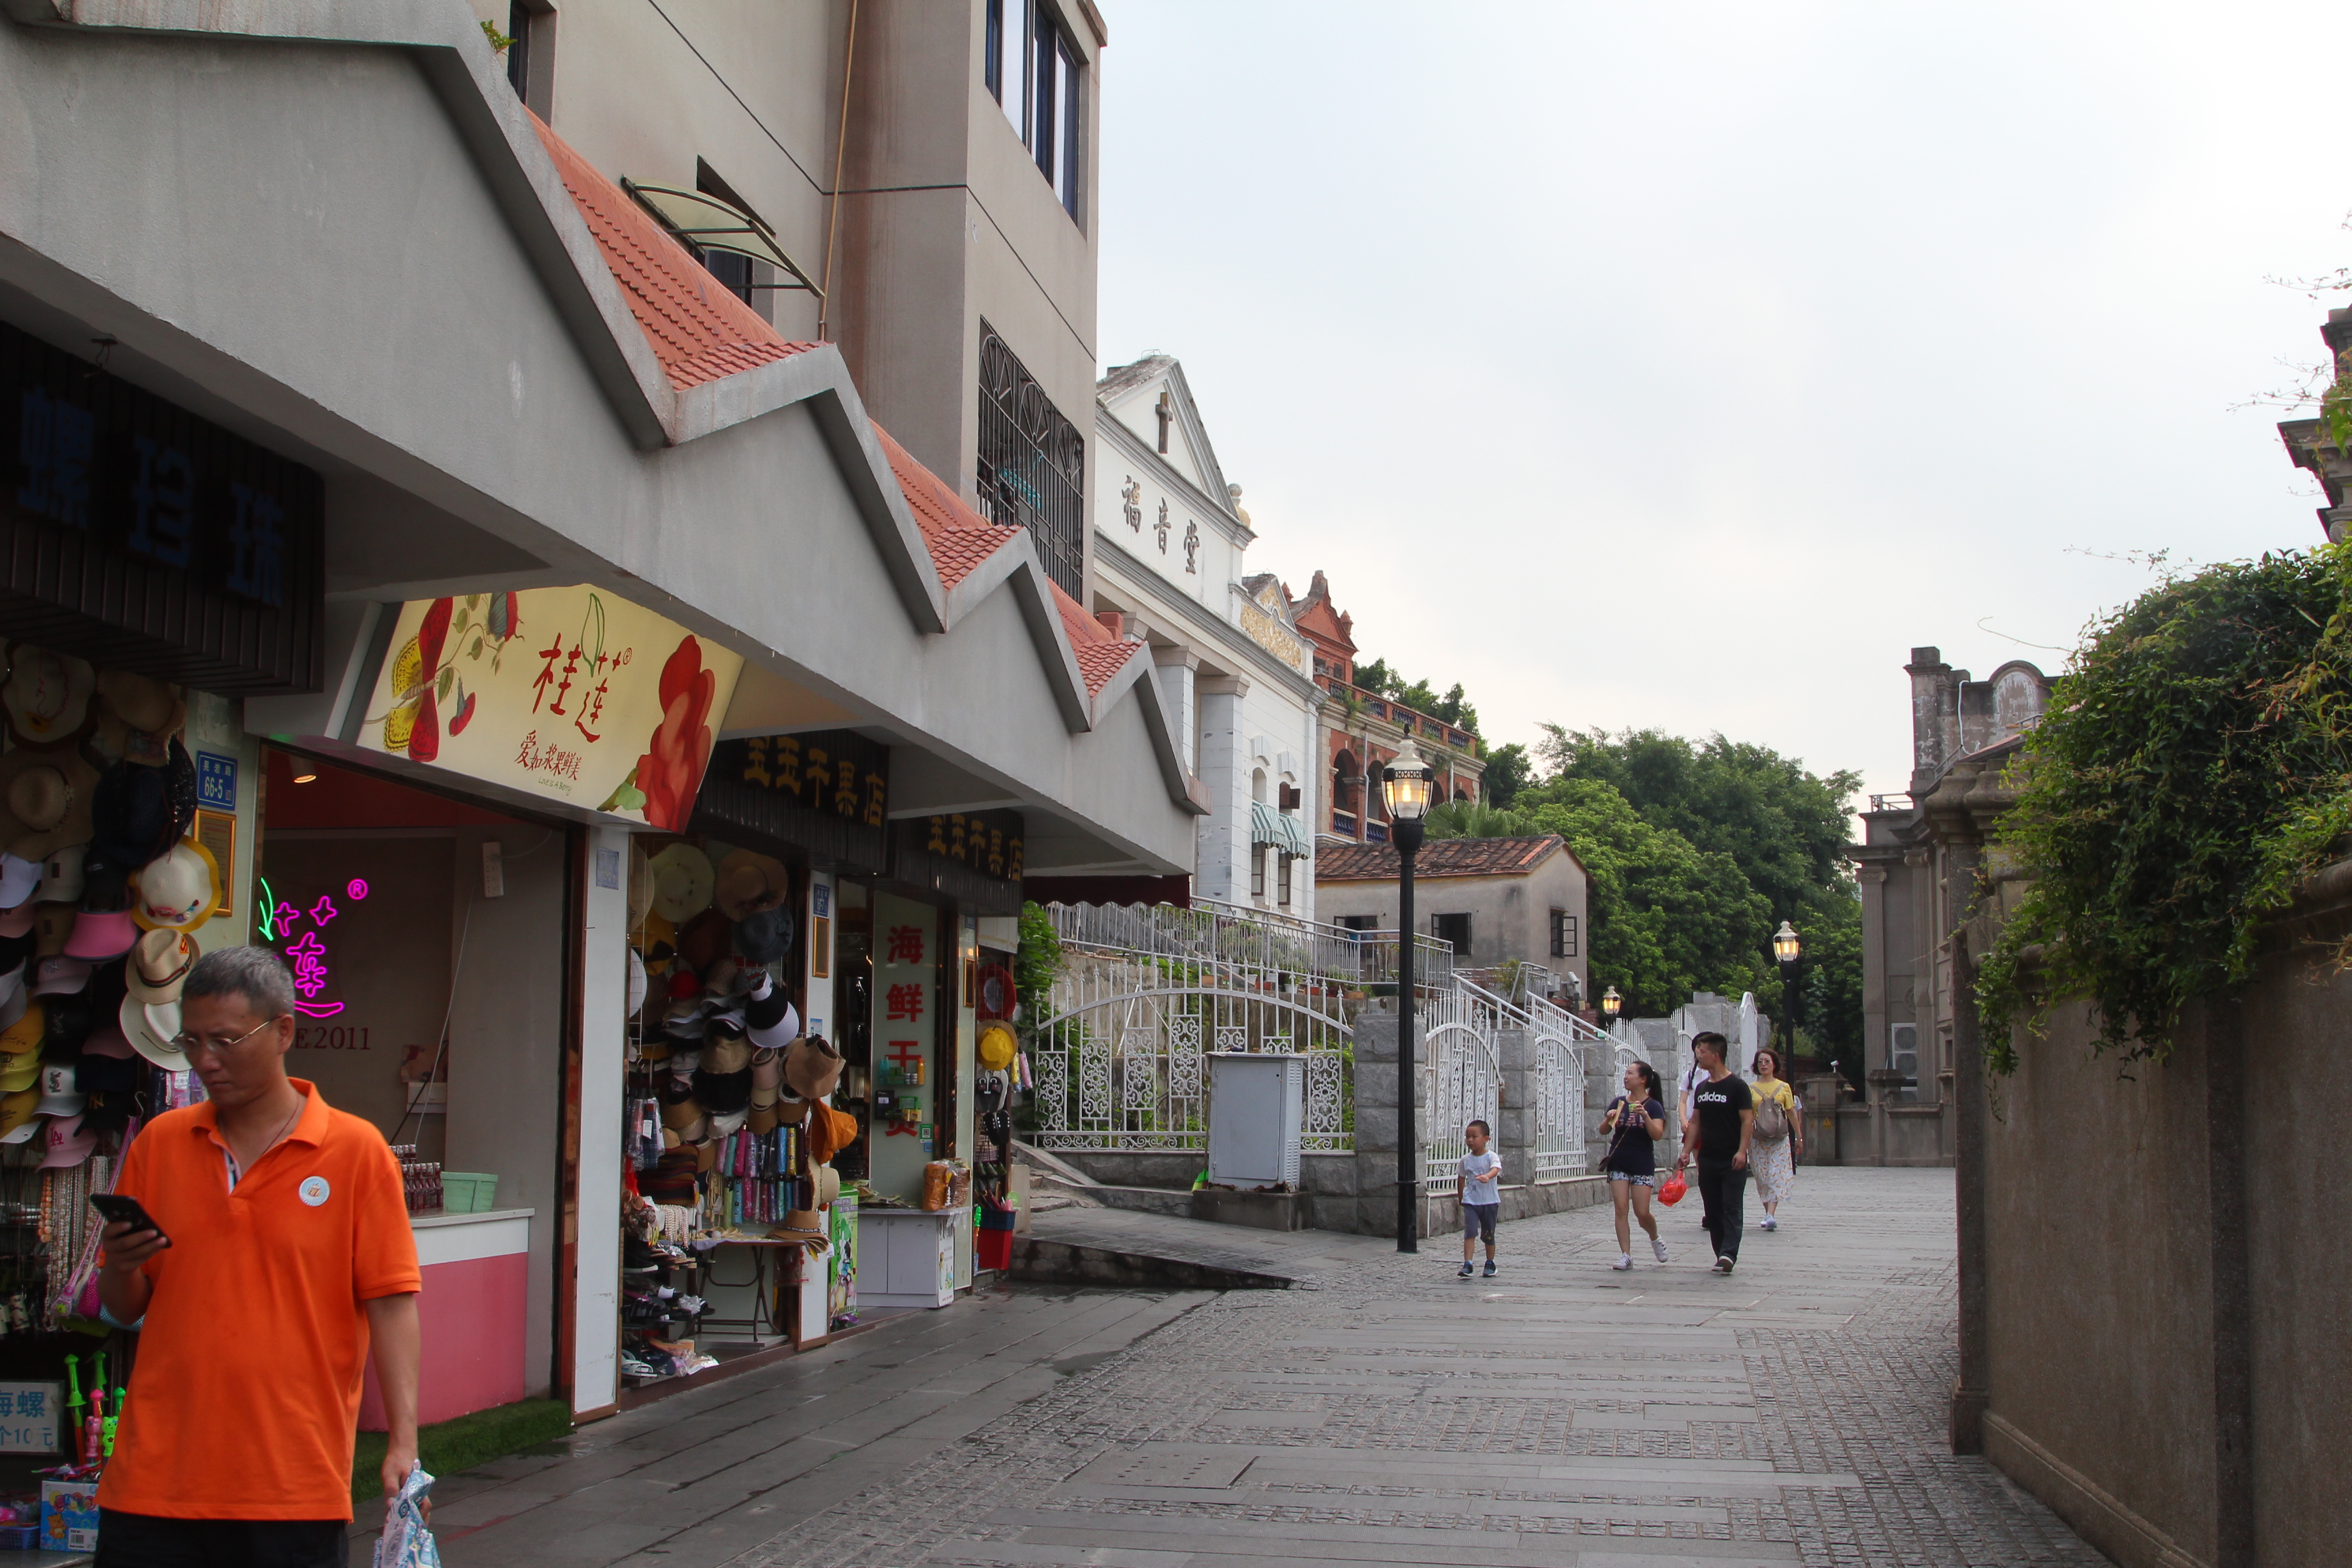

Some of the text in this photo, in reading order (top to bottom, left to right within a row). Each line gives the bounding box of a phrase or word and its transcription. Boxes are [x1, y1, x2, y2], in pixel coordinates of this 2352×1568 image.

[1122, 474, 1200, 574] 福音堂
[532, 632, 621, 743] 桂莲
[514, 730, 582, 781] 爱如浆果鲜美
[203, 760, 232, 777] 晃岩路
[204, 776, 223, 800] 66-5
[538, 776, 549, 787] Love
[553, 781, 559, 789] A
[559, 781, 572, 796] Berry
[314, 1026, 371, 1050] 2011
[1697, 1091, 1727, 1103] adidas
[50, 1127, 64, 1147] LA
